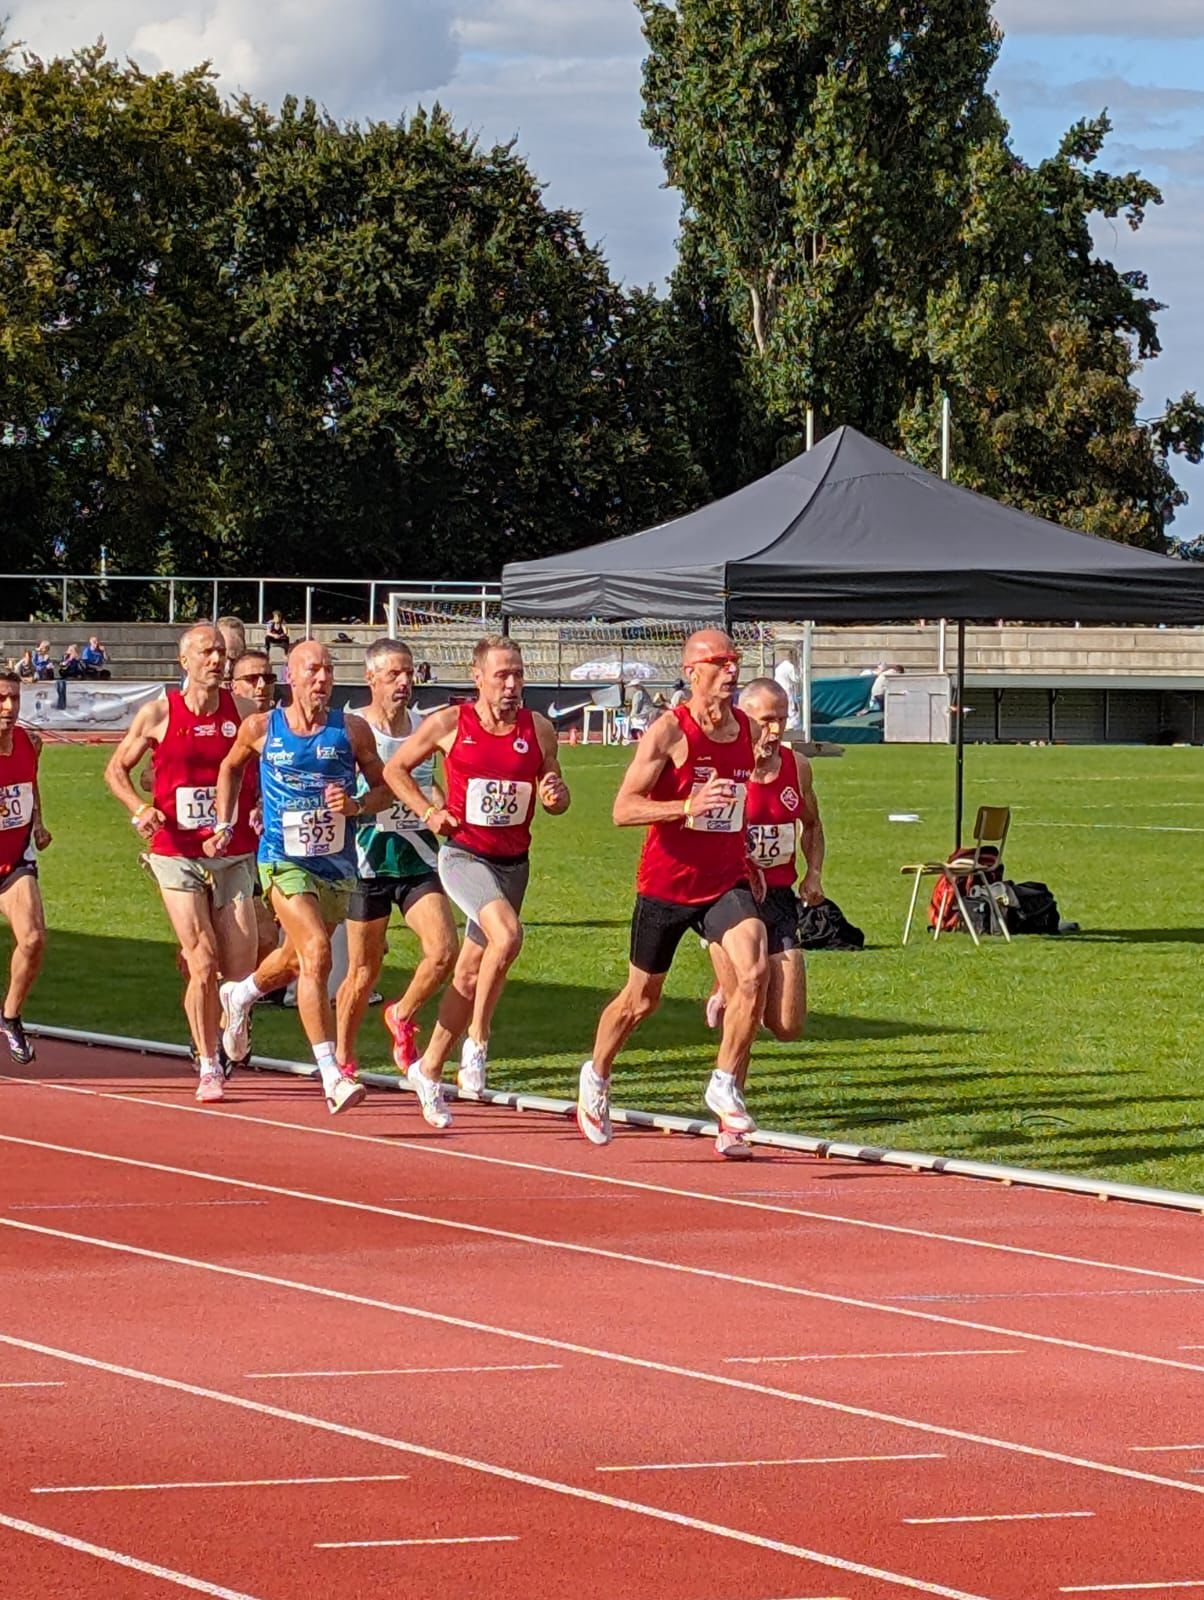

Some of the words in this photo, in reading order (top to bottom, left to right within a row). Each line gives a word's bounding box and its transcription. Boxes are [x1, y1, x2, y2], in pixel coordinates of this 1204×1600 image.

[193, 788, 217, 801] GL
[301, 810, 334, 825] GLS
[299, 825, 336, 844] 593
